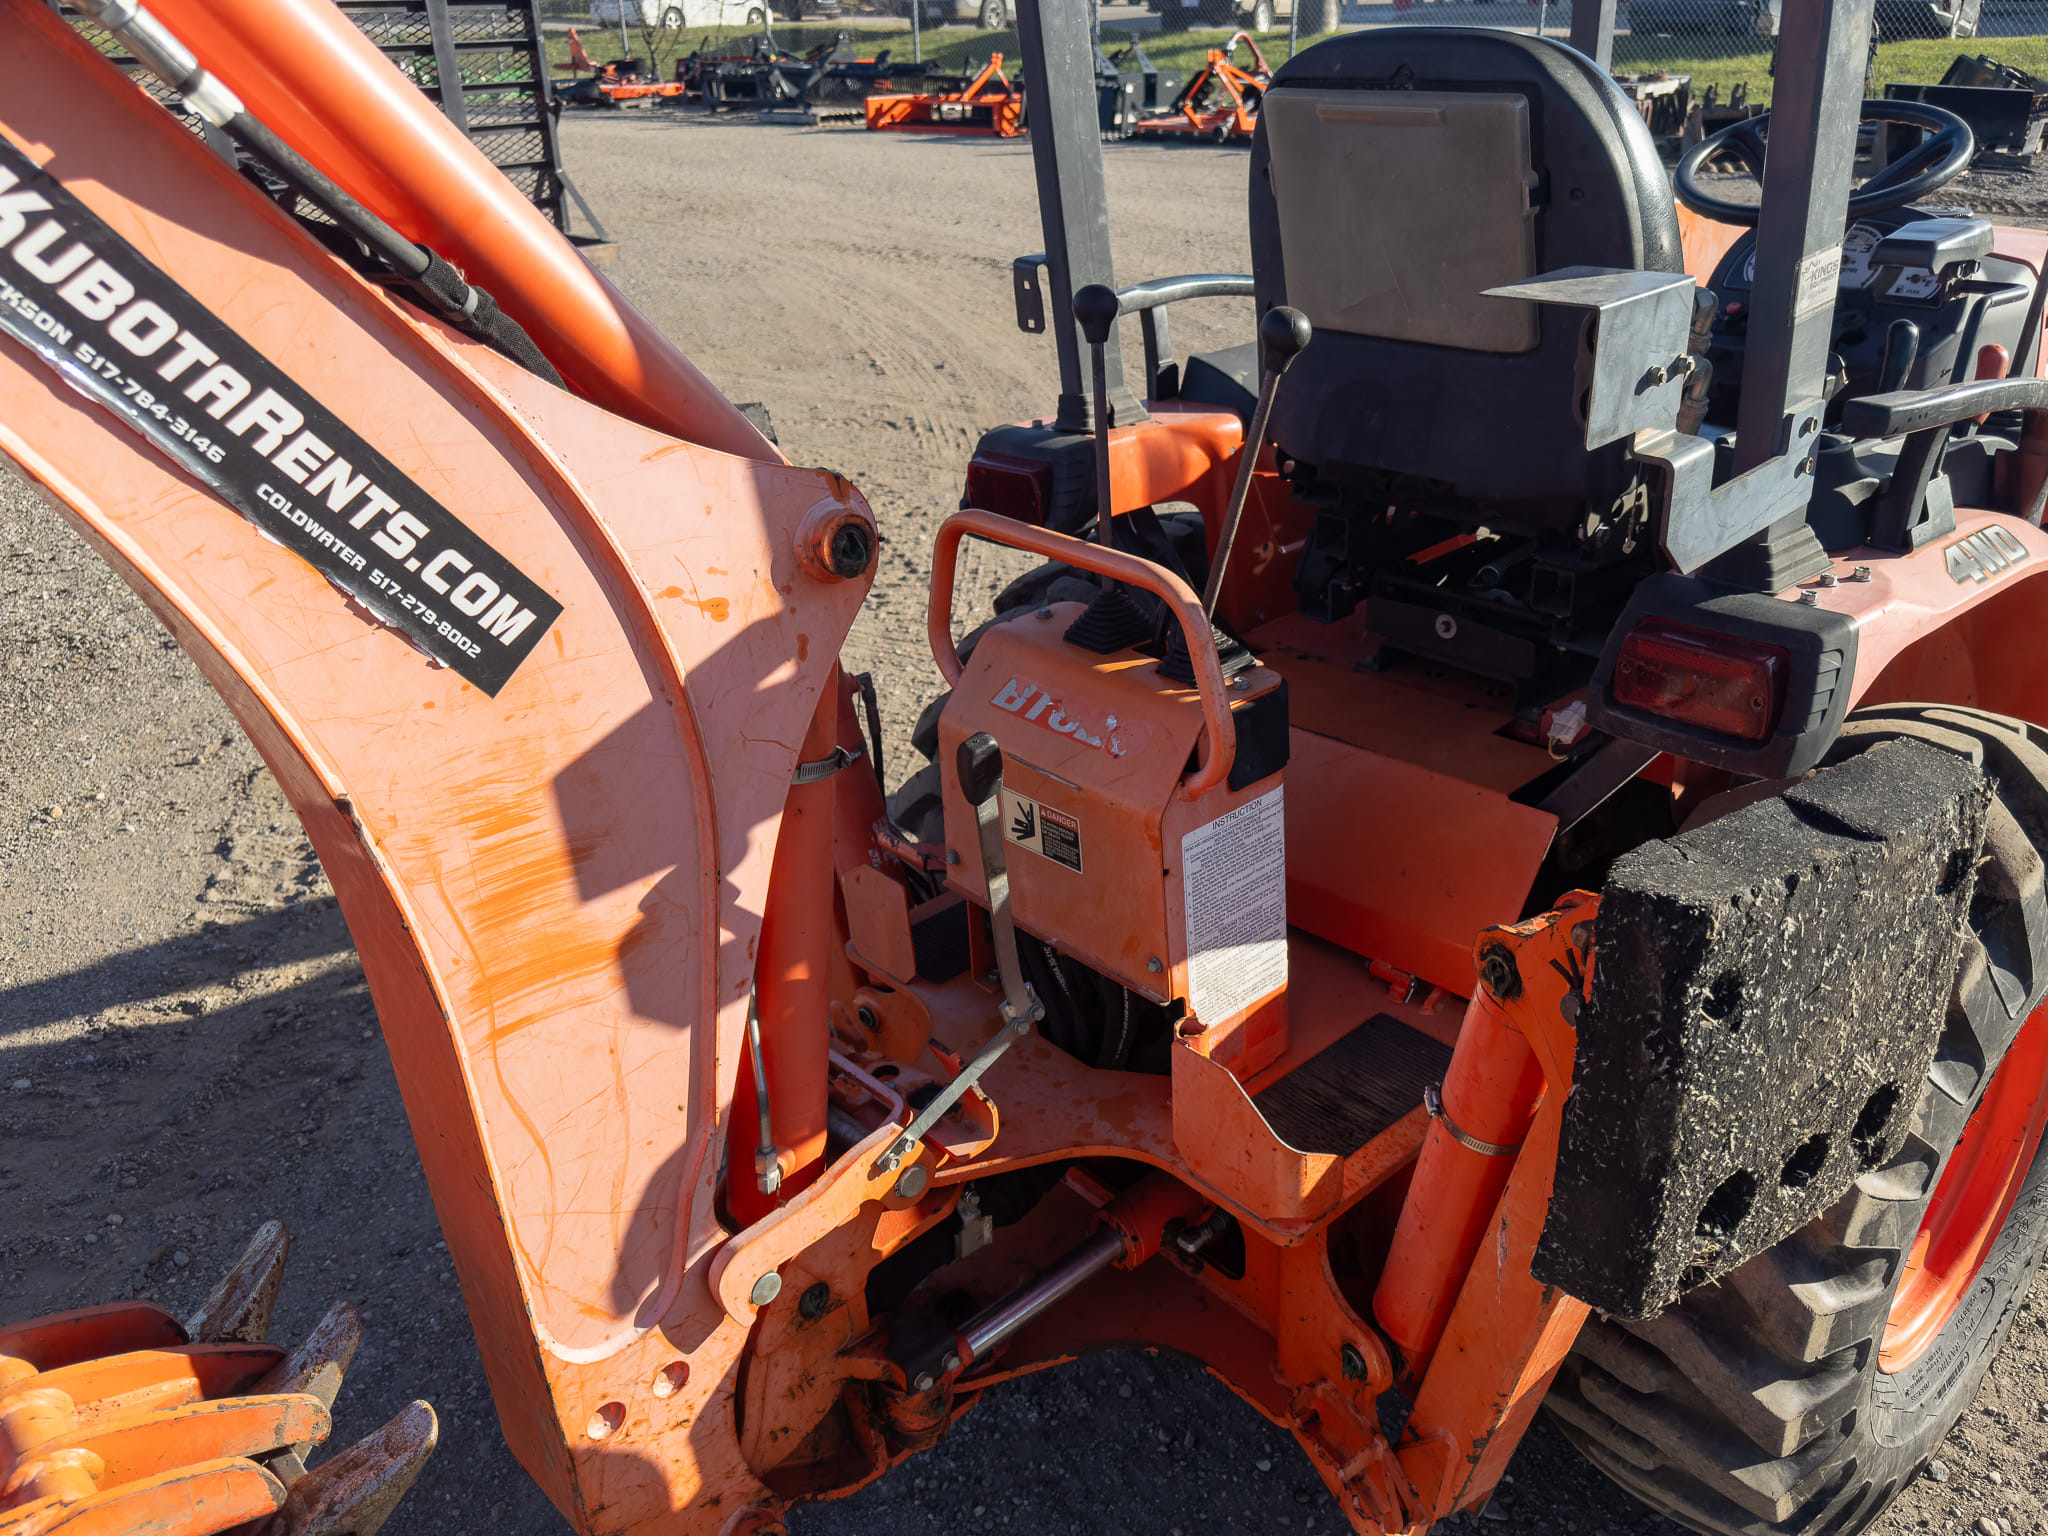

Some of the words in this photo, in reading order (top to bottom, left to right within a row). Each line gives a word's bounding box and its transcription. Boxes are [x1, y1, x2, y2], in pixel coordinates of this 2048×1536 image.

[1811, 259, 1839, 281] KINGS
[0, 164, 538, 647] KUBOTARENTS.COM
[73, 342, 227, 464] 517-784-3146
[256, 483, 367, 572] COLDWATER
[368, 568, 482, 660] 517-279-8002
[1944, 523, 2030, 584] 4WD
[1046, 809, 1077, 829] DANGER
[1212, 799, 1263, 831] INSTRUCTION
